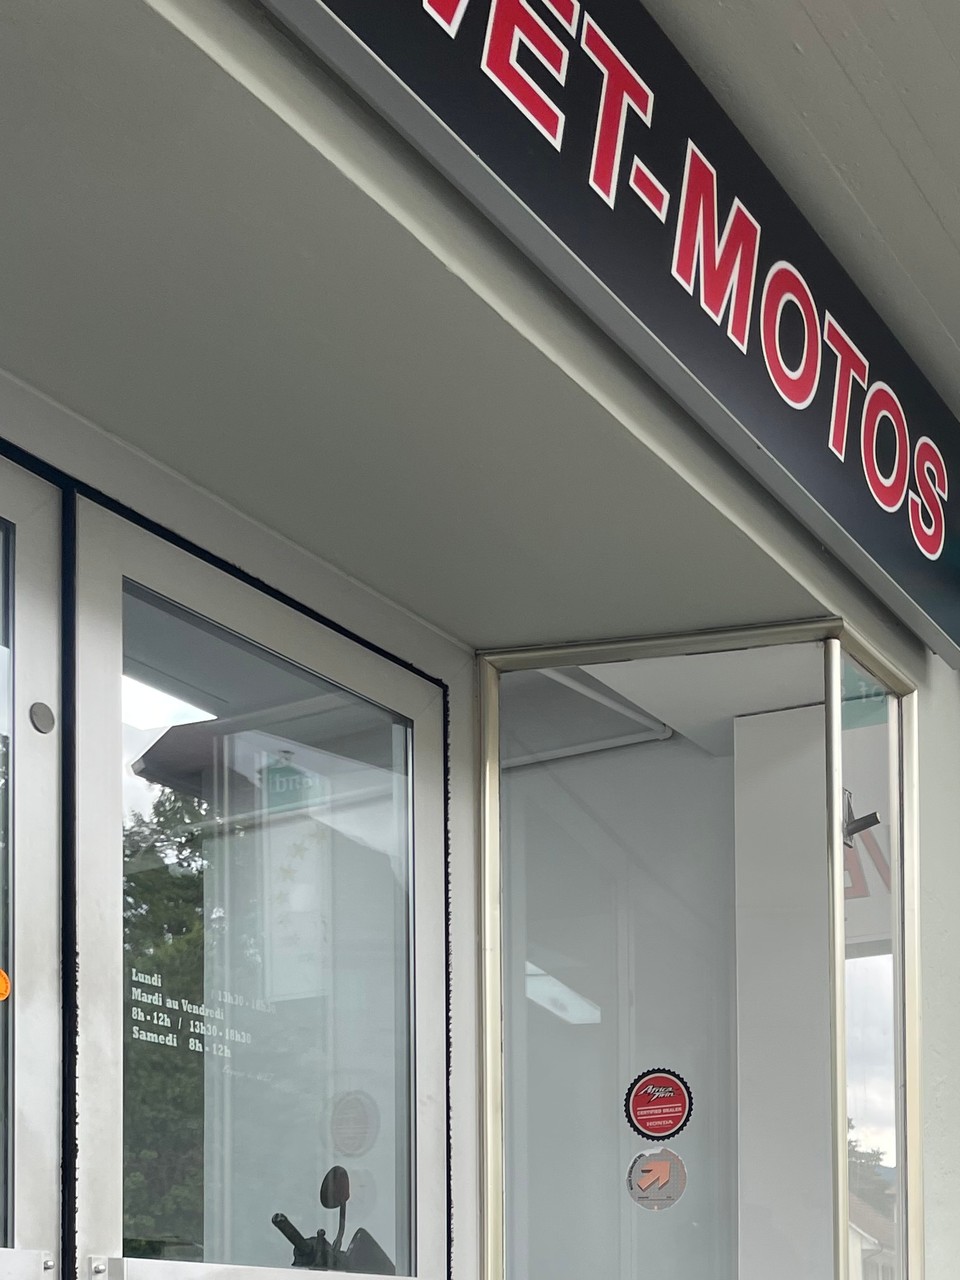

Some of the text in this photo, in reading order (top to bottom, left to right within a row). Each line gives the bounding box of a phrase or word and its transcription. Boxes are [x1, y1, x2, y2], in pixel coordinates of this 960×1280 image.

[423, 0, 948, 561] ET-MOTOS
[131, 968, 162, 987] Lundi
[131, 987, 224, 1020] Mardi au Vendredi
[132, 1026, 177, 1047] Samedi
[638, 1085, 673, 1096] Africa
[650, 1092, 674, 1102] Twin
[646, 1119, 674, 1127] HONDA
